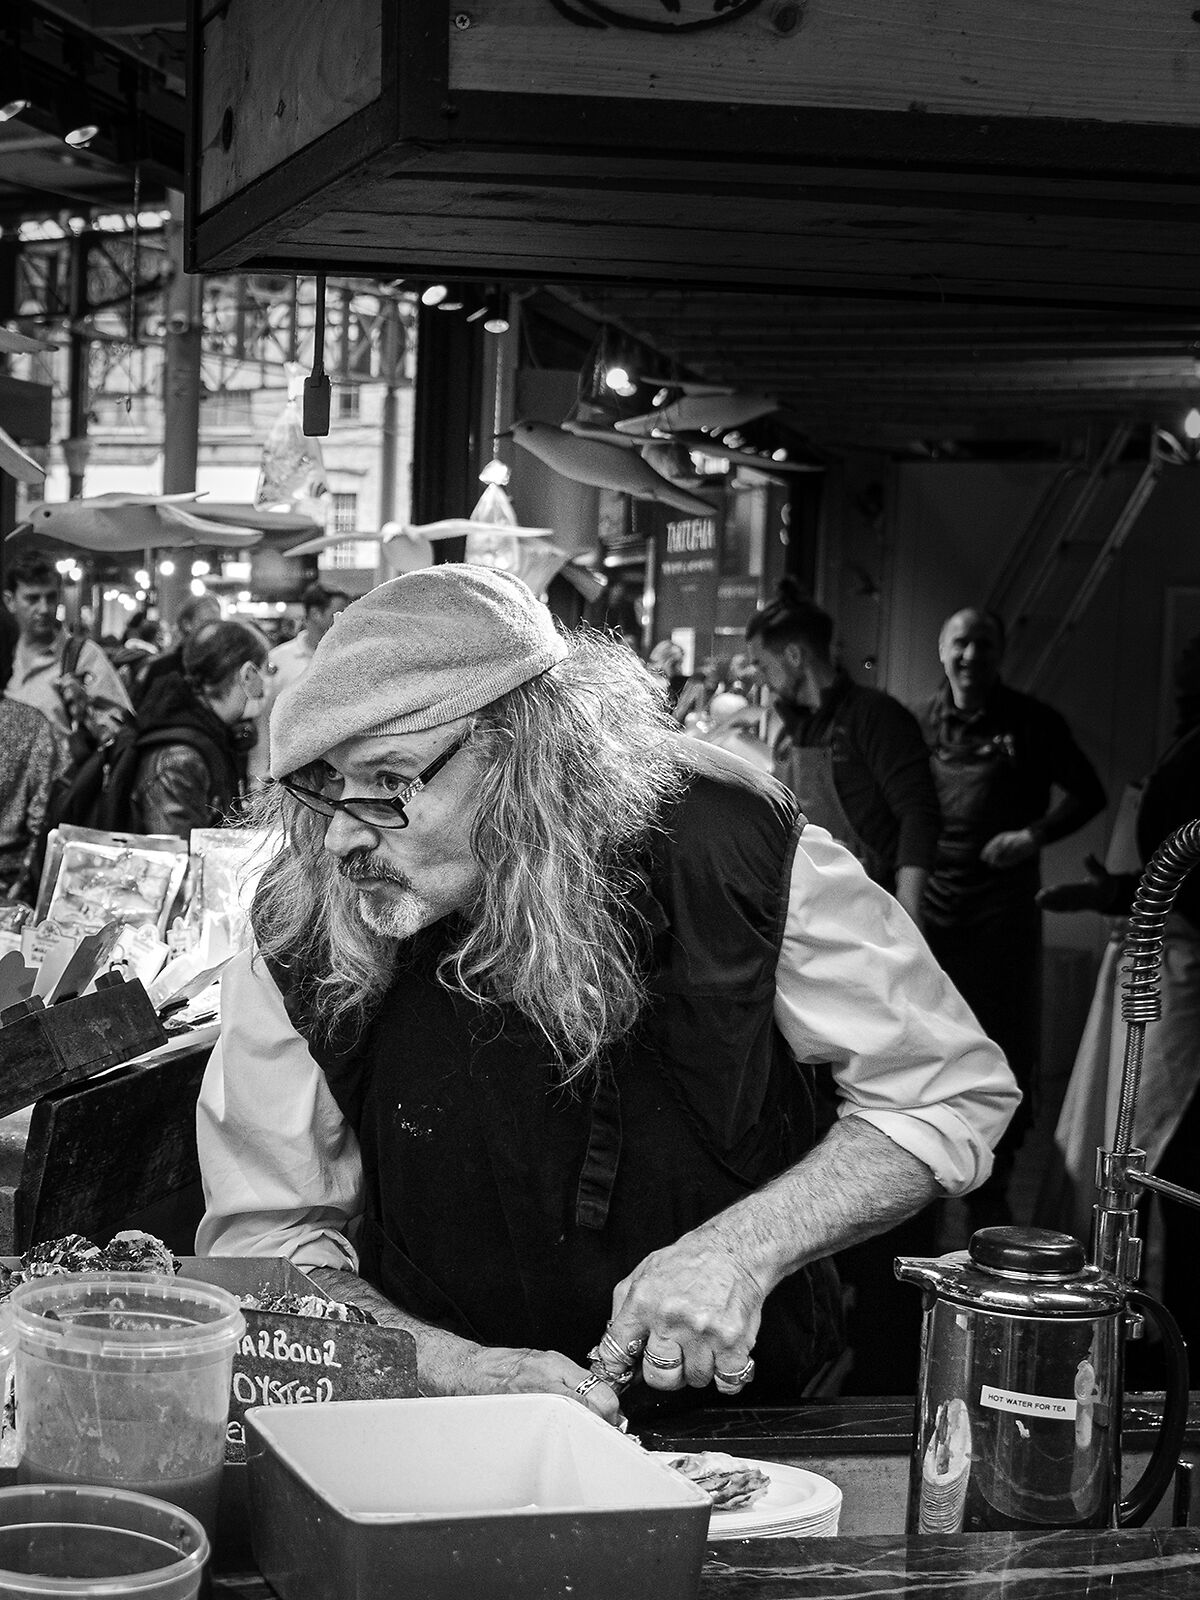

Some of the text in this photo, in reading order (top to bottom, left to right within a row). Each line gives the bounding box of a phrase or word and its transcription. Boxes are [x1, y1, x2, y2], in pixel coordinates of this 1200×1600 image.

[988, 1394, 1067, 1413] HOT WATER FOR TEA
